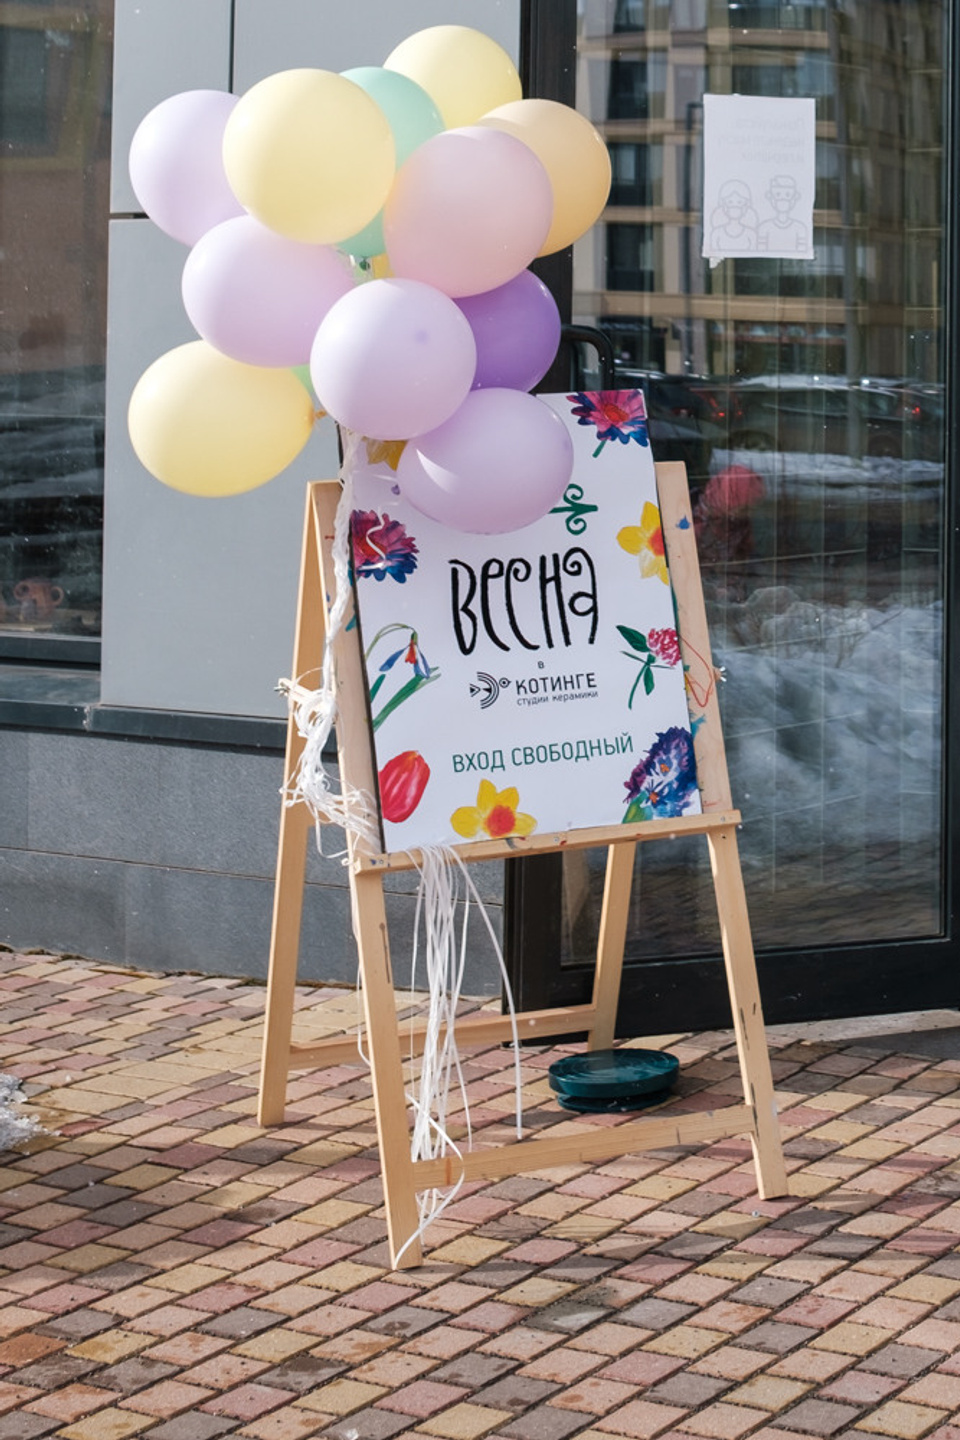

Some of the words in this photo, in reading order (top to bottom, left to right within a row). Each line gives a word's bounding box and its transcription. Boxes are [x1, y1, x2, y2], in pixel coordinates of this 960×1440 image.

[515, 672, 597, 695] КОТИНГЕ
[516, 695, 549, 707] студии
[552, 690, 599, 703] керамики
[452, 750, 506, 773] ВХОД
[511, 731, 634, 767] СВОБОДНЫЙ
